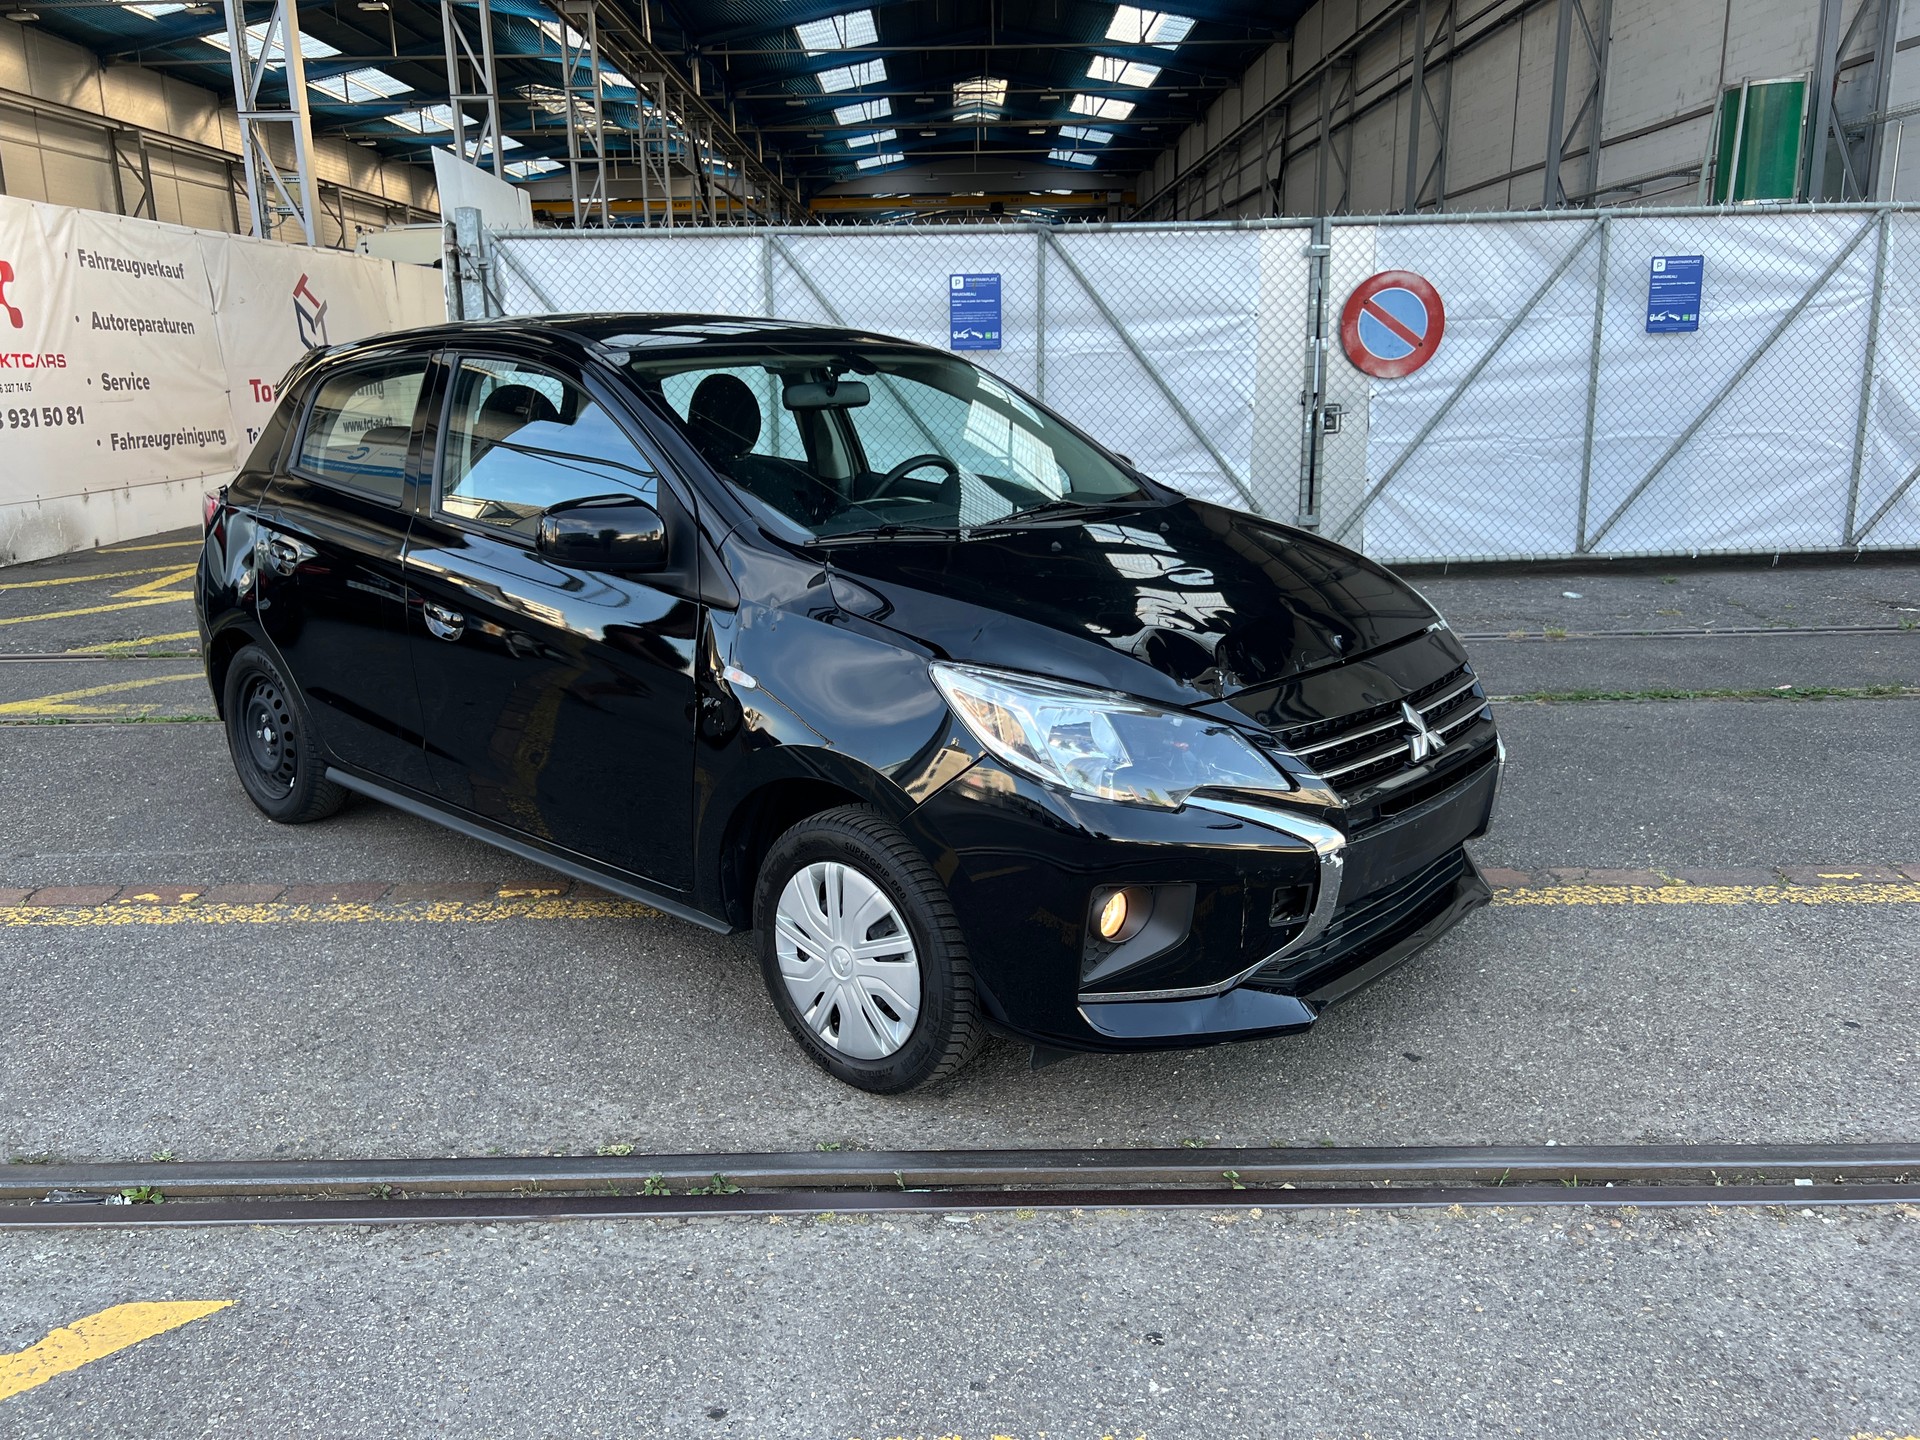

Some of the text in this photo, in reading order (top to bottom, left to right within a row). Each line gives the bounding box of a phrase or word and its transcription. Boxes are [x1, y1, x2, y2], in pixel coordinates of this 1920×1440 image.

[77, 248, 185, 280] Fahrzeugverkauf
[91, 311, 195, 337] Autoreparaturen
[4, 383, 15, 393] 327
[16, 383, 24, 393] 74
[24, 382, 32, 392] 05
[101, 371, 151, 391] Service
[8, 407, 39, 429] 931
[42, 406, 63, 427] 50
[66, 405, 85, 426] 81
[110, 426, 227, 451] Fahrzeugreinigung
[844, 841, 890, 878] SUPERGRIP
[890, 879, 907, 900] PRO
[806, 1042, 831, 1067] 165/65
